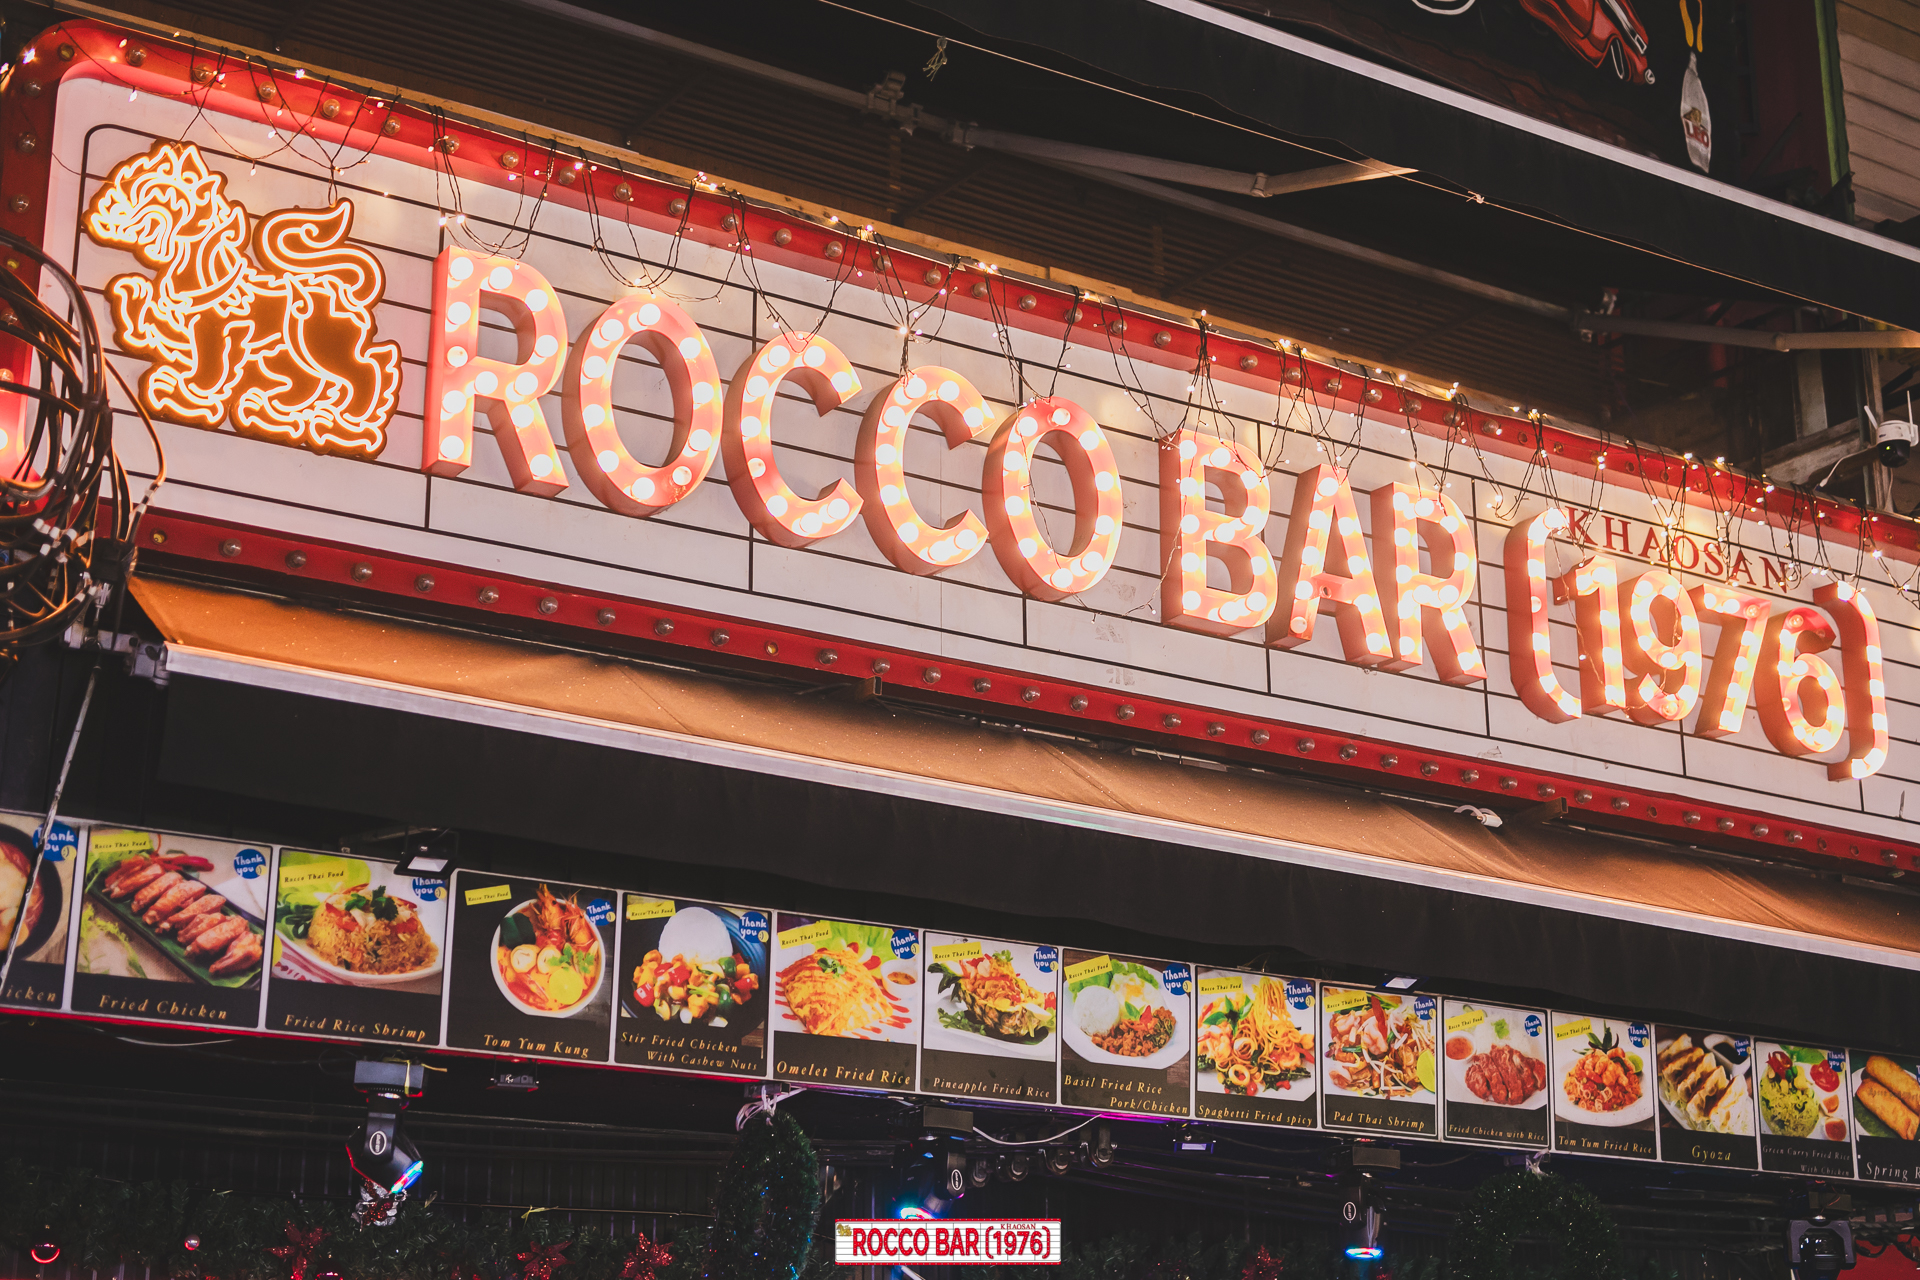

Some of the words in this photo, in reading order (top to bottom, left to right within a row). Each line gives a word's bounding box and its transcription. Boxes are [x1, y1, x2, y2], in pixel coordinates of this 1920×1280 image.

[1685, 120, 1710, 148] LEO
[421, 243, 1123, 600] ROCCO
[1159, 428, 1487, 685] BAR
[1504, 506, 1888, 781] (1976)
[1565, 505, 1788, 594] KHAOSAN
[234, 854, 263, 866] Thank
[236, 866, 254, 877] you
[327, 871, 344, 879] Food
[587, 902, 612, 916] Thank
[590, 914, 605, 925] you
[739, 917, 767, 929] Thank
[740, 929, 757, 940] you
[800, 934, 814, 942] Thai
[815, 930, 829, 938] Food
[891, 933, 916, 947] Thank
[894, 946, 910, 957] you
[1035, 951, 1057, 961] Thank
[1036, 960, 1050, 970] you
[1163, 969, 1189, 980] Thank
[1165, 981, 1181, 993] you
[1287, 984, 1312, 995] Thank
[99, 994, 150, 1012] Fried
[156, 1000, 228, 1020] Chicken
[1288, 997, 1305, 1007] you
[1414, 1000, 1434, 1010] Thank
[1415, 1009, 1428, 1018] you
[284, 1014, 327, 1029] Fried
[333, 1019, 365, 1033] Rice
[373, 1022, 426, 1042] Shrimp
[1628, 1025, 1648, 1035] Thank
[483, 1034, 511, 1049] Tom
[518, 1037, 546, 1052] Yum
[553, 1041, 589, 1058] Kung
[620, 1032, 646, 1045] Stir
[651, 1034, 685, 1048] Fried
[690, 1038, 738, 1053] Chicken
[1629, 1035, 1641, 1045] you
[1735, 1039, 1750, 1048] Thank
[1736, 1048, 1746, 1056] you
[1828, 1051, 1845, 1060] Thank
[647, 1050, 676, 1064] With
[681, 1053, 725, 1068] Cashew
[730, 1058, 758, 1071] Nuts
[1828, 1060, 1840, 1068] you
[776, 1060, 828, 1077] Omelet
[835, 1065, 875, 1082] Fried
[880, 1070, 911, 1085] Rice
[933, 1077, 987, 1093] Pineapple
[992, 1083, 1022, 1096] Fried
[1026, 1086, 1050, 1098] Rice
[1064, 1074, 1096, 1088] Basil
[1100, 1078, 1133, 1093] Fried
[1137, 1082, 1163, 1095] Rice
[1109, 1096, 1188, 1115] Pork/Chicken
[1198, 1105, 1250, 1120] Spaghetti
[1254, 1110, 1283, 1123] Fried
[1286, 1113, 1313, 1127] spicy
[1333, 1110, 1353, 1122] Pad
[1357, 1113, 1382, 1125] Thai
[1387, 1116, 1425, 1132] Shrimp
[1448, 1124, 1470, 1134] Fried
[1472, 1126, 1503, 1138] Chicken
[1506, 1129, 1524, 1139] with
[1527, 1131, 1545, 1141] Rice
[1559, 1135, 1576, 1146] Tom
[1581, 1137, 1600, 1149] Yum
[1603, 1140, 1628, 1151] Fried
[1632, 1143, 1652, 1154] Rice
[1691, 1145, 1731, 1163] Gyoza
[1762, 1145, 1784, 1155] Green
[1787, 1147, 1809, 1158] Curry
[1812, 1150, 1832, 1159] Fried
[1834, 1152, 1850, 1161] Rice
[1800, 1164, 1818, 1174] With
[1821, 1166, 1850, 1176] Chicken
[1866, 1162, 1909, 1182] Spring
